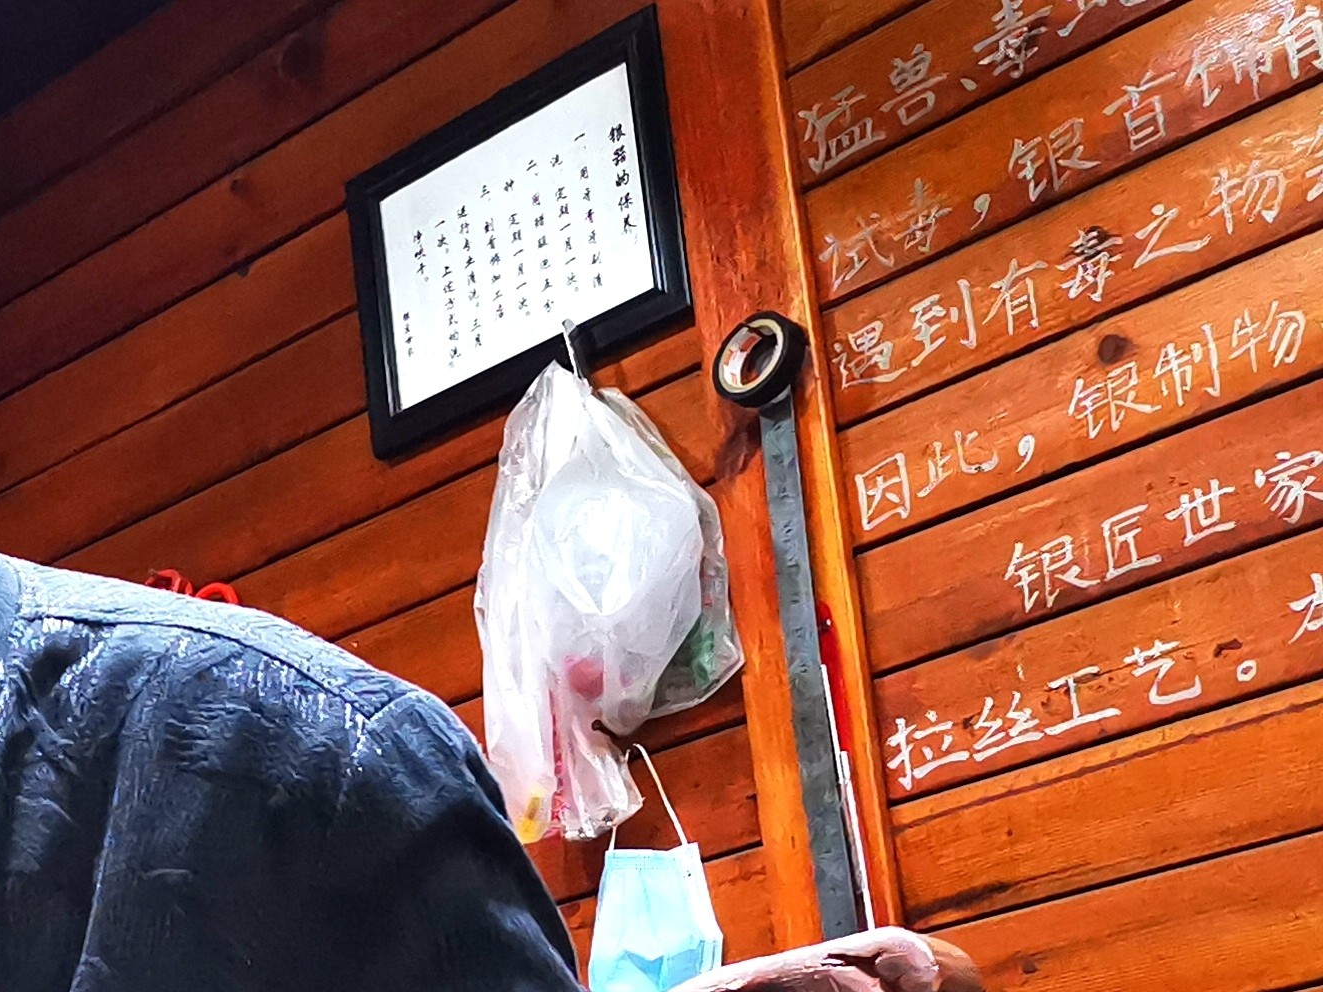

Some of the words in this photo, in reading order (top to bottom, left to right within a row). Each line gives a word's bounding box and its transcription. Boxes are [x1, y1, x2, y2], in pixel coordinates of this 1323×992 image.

[799, 0, 1151, 173] 猛兽、毒
[1003, 451, 1323, 614] 银匠世家
